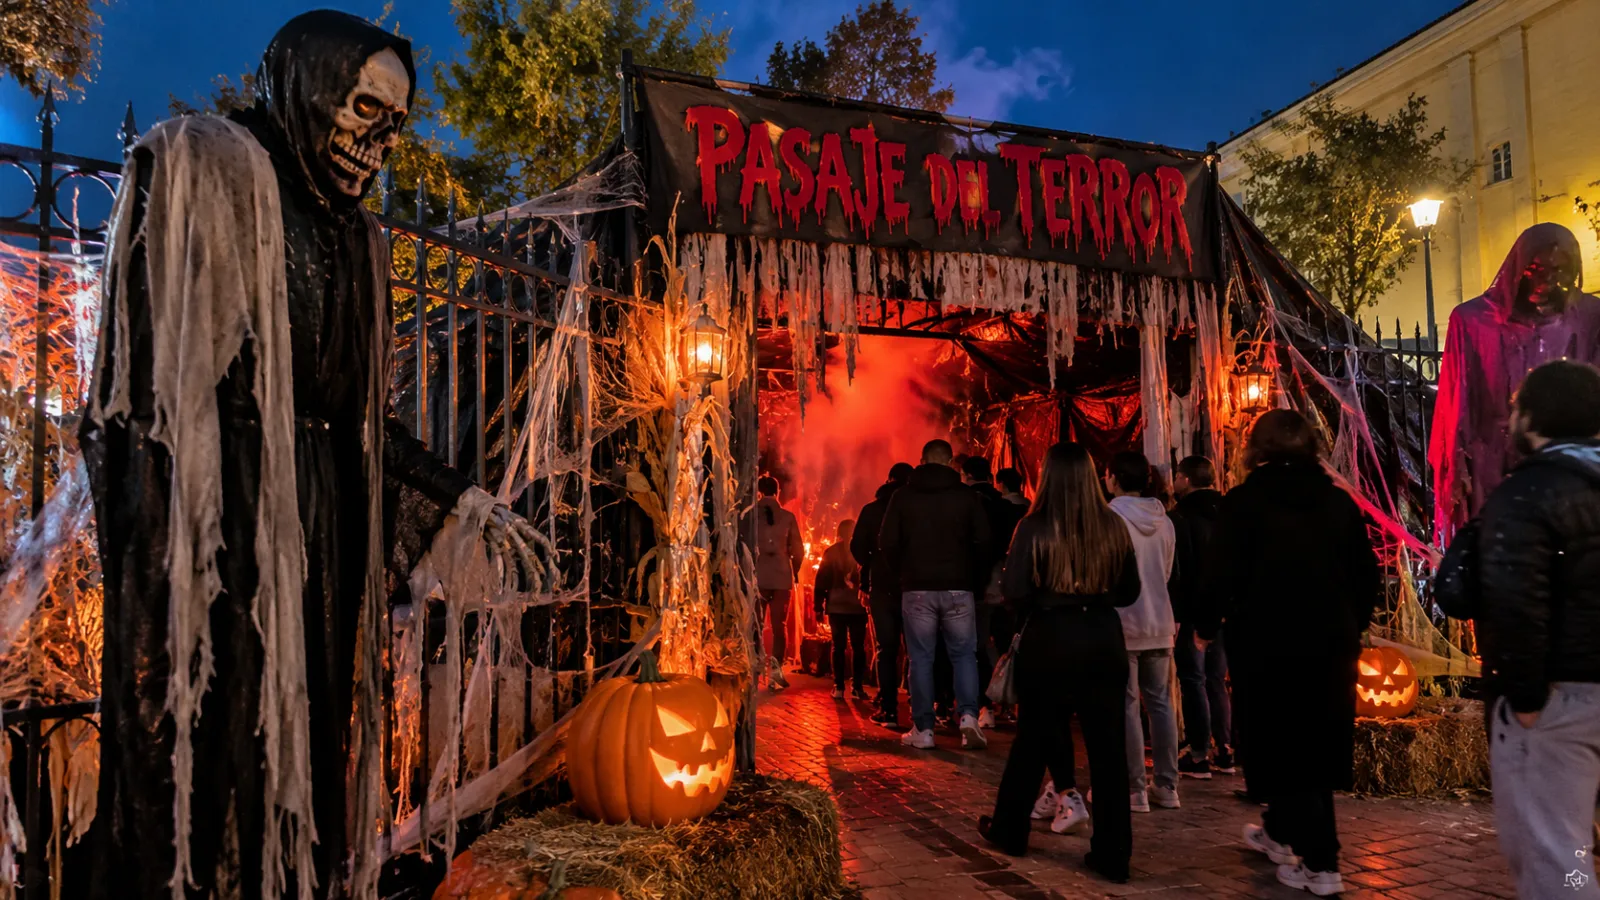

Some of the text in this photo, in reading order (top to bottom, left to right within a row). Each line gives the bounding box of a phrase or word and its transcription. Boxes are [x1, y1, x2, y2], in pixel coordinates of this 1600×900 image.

[685, 105, 1193, 272] PASAJE DEL TERROR
